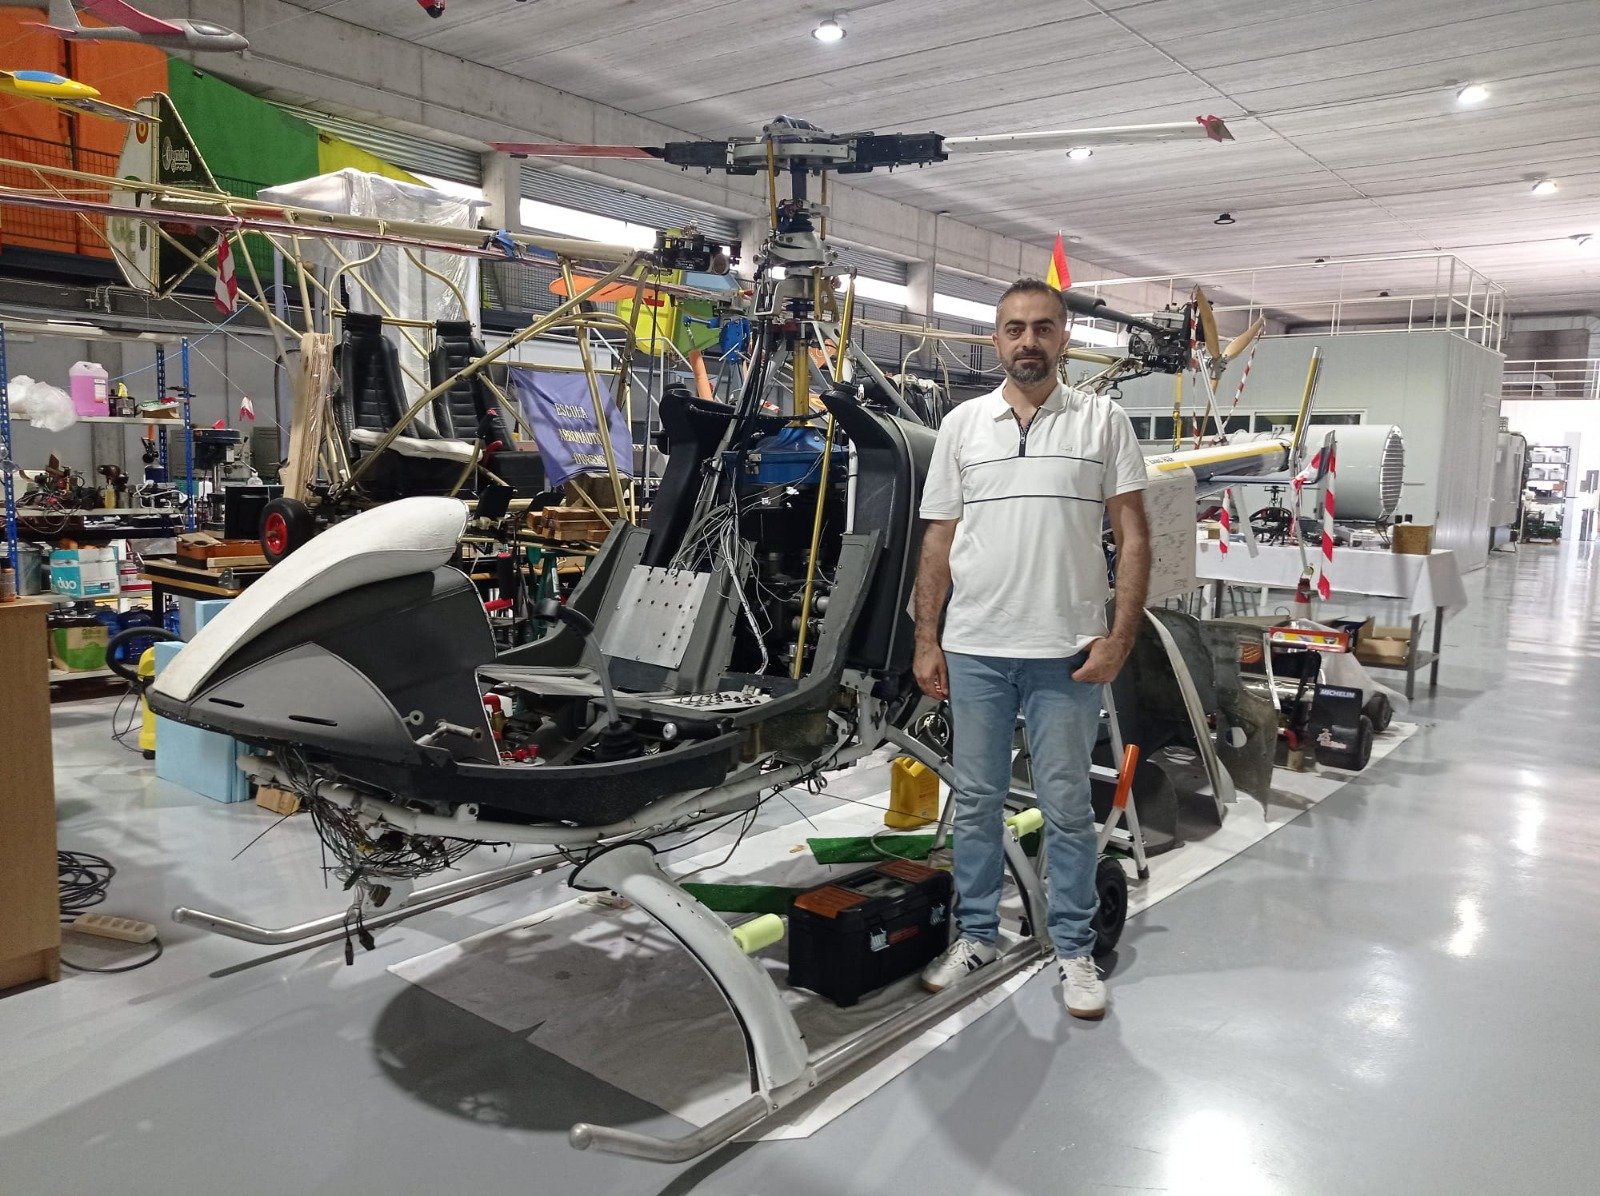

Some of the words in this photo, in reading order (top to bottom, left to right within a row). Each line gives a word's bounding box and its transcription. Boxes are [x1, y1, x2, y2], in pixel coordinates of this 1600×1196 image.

[555, 403, 588, 418] ESCOLA
[559, 428, 603, 446] AERONÁUTIC
[1319, 688, 1356, 699] MICHELIN
